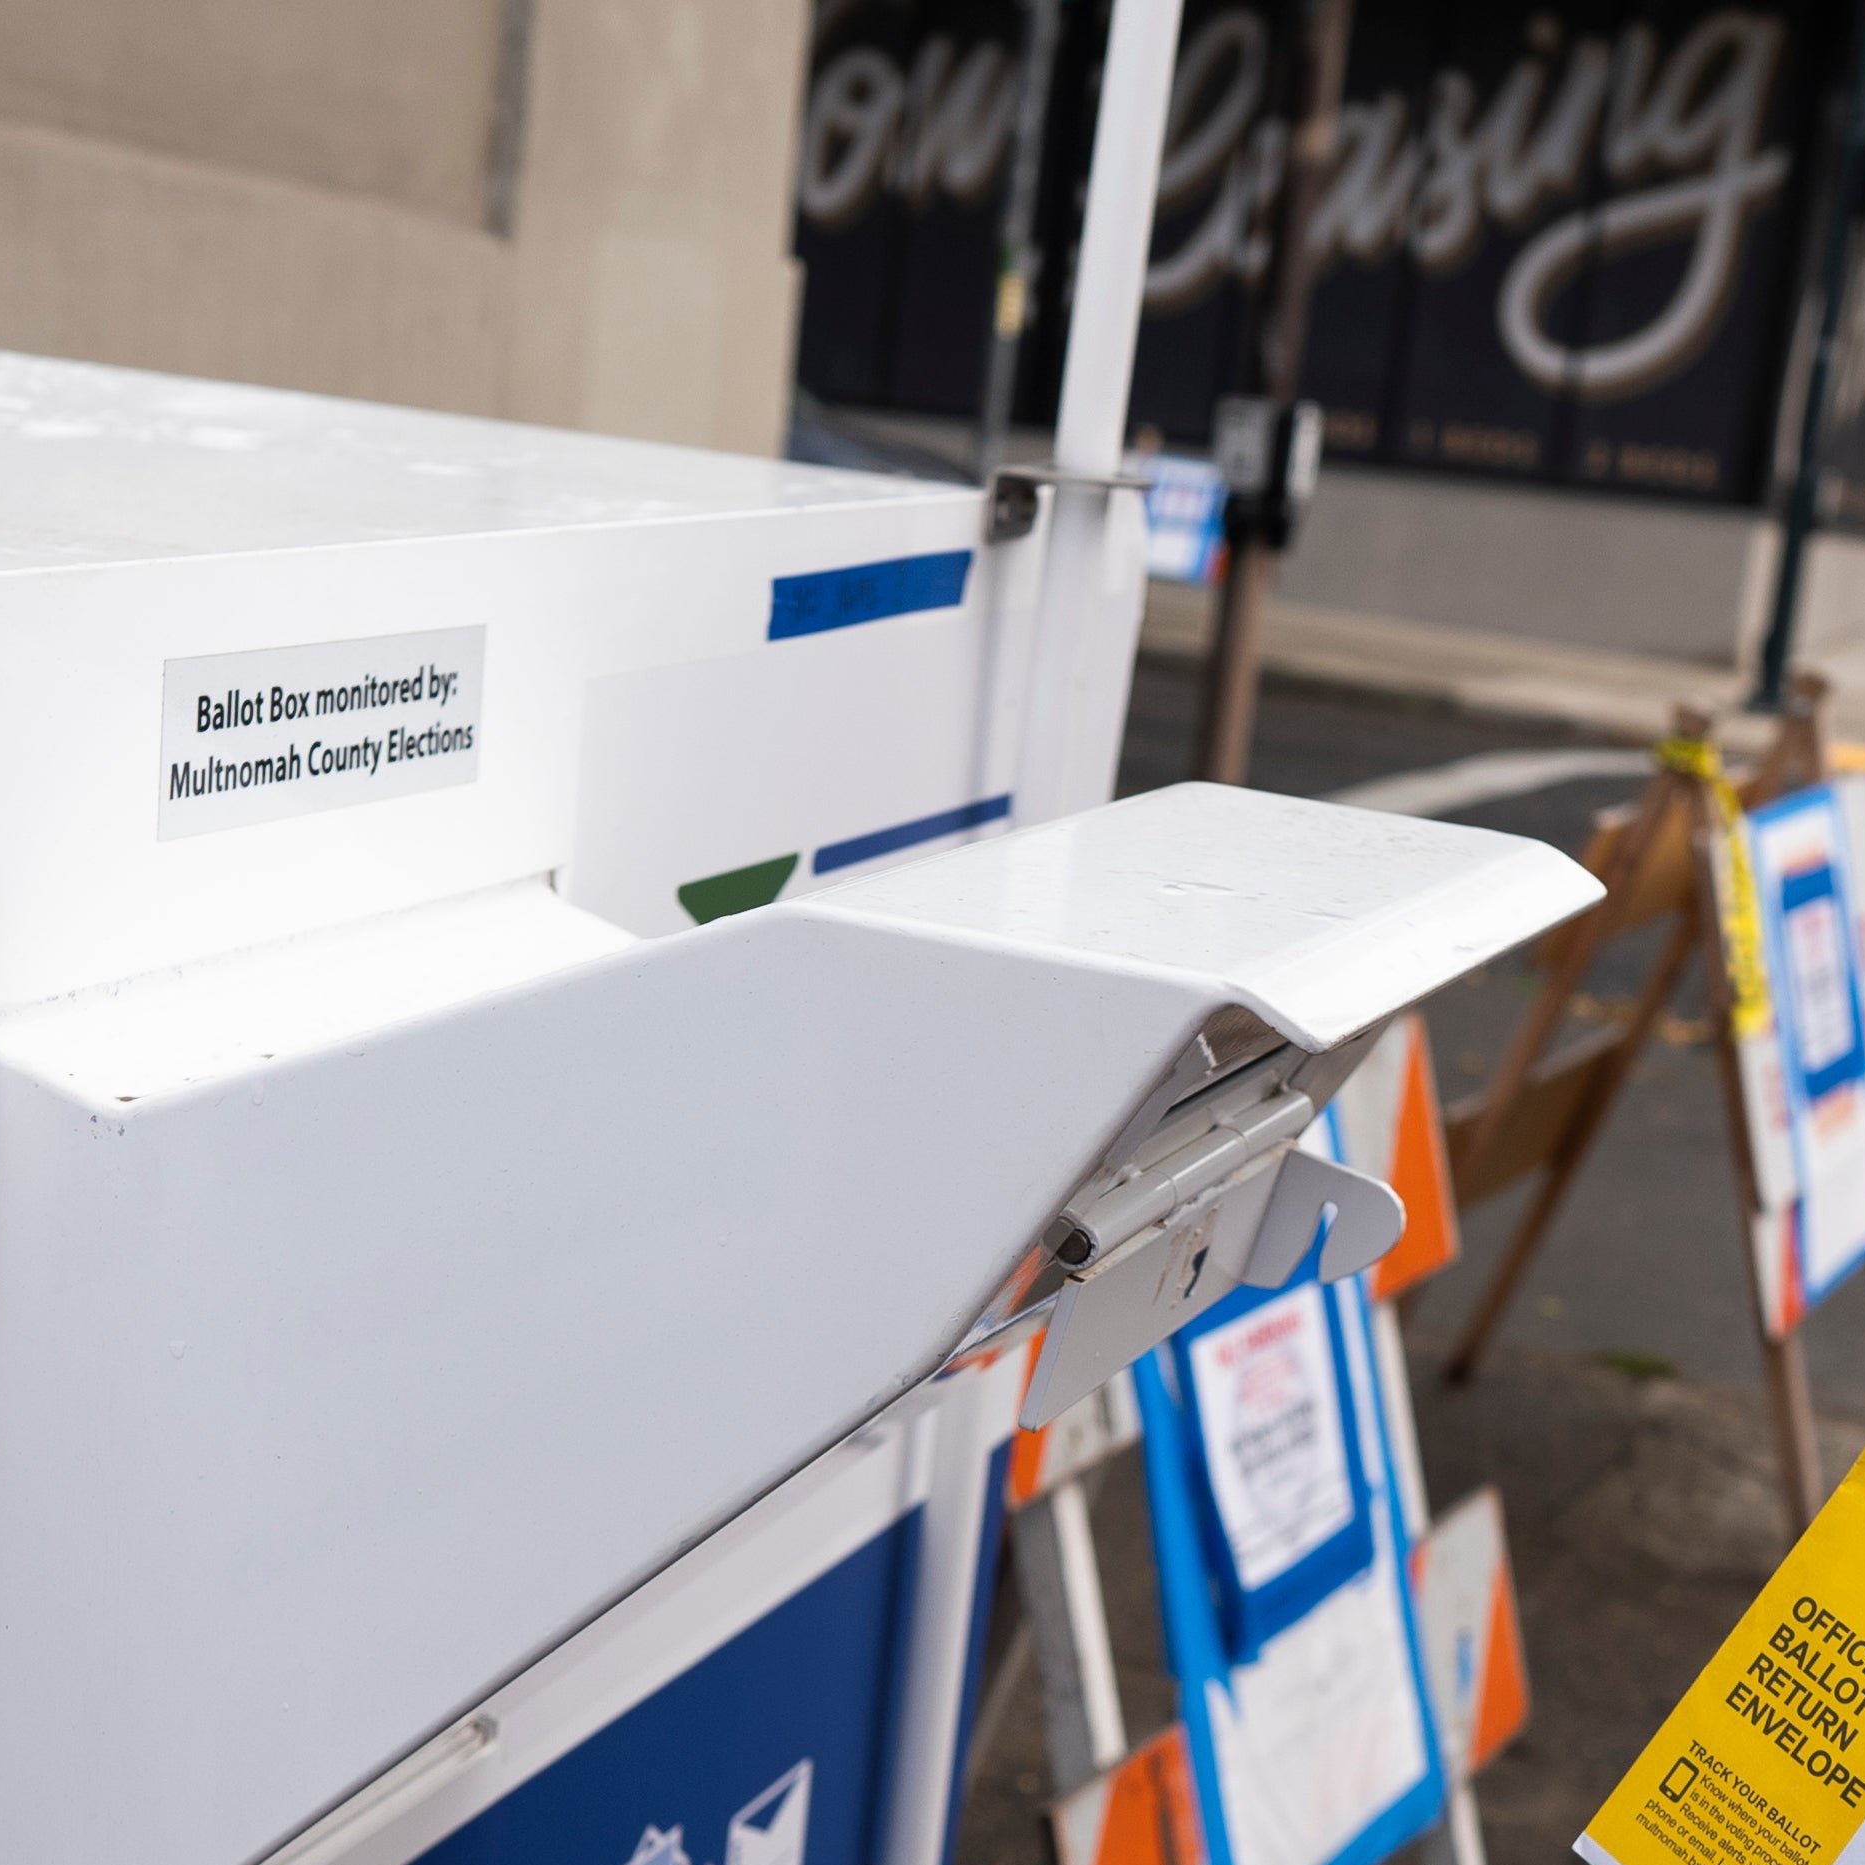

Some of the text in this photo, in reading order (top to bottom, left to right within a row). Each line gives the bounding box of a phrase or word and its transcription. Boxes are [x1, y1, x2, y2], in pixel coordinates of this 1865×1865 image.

[196, 663, 458, 732] Ballot Box monitored by:
[169, 722, 474, 800] Multnomah County Elections
[1747, 1652, 1859, 1753] RETURN
[1645, 1798, 1677, 1828] phone
[1677, 1825, 1690, 1837] or
[1688, 1836, 1717, 1863] email.
[1689, 1739, 1822, 1854] TRACK YOUR BALLOT
[1689, 1788, 1700, 1802] is
[1698, 1795, 1710, 1811] in
[1709, 1805, 1725, 1825] the
[1725, 1820, 1754, 1850] voting
[1700, 1774, 1728, 1803] Know
[1727, 1800, 1758, 1827] where
[1755, 1822, 1781, 1847] your
[1679, 1803, 1718, 1841] Receive
[1718, 1838, 1747, 1865] alerts
